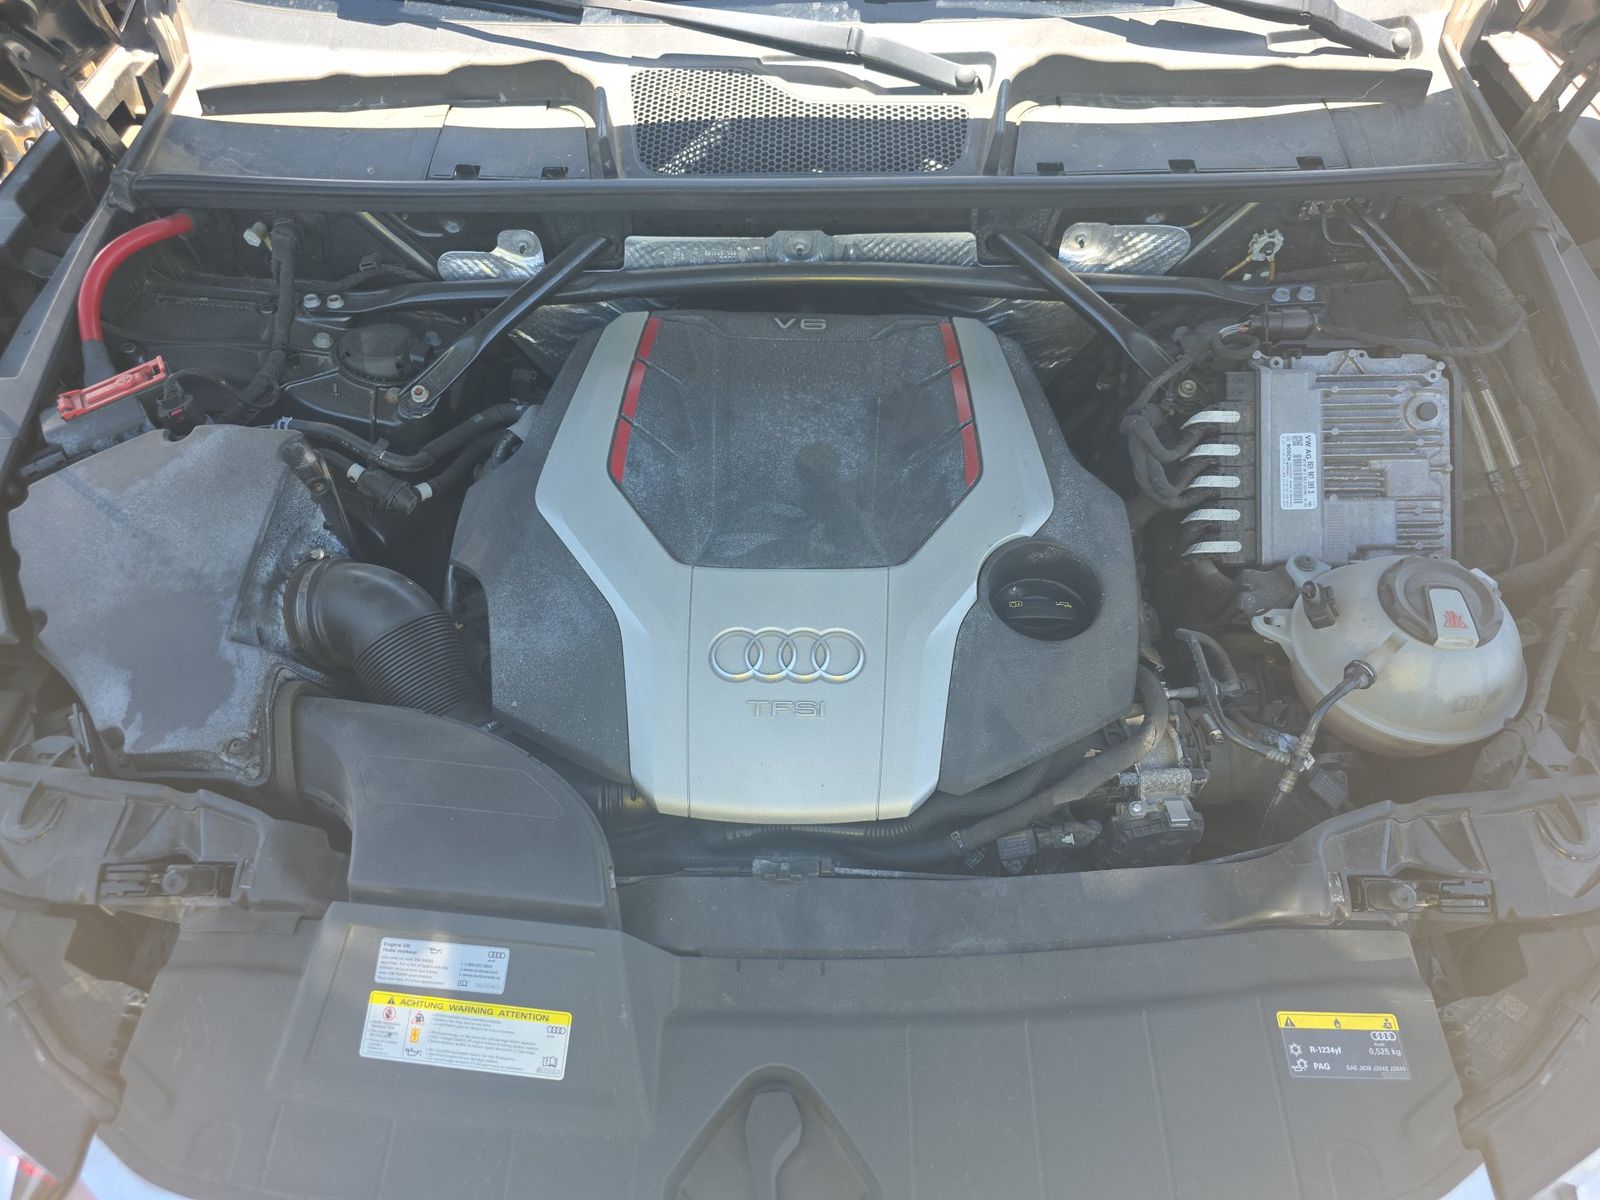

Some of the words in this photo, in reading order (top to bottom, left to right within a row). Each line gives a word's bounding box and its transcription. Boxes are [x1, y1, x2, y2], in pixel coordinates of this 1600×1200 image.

[773, 317, 827, 330] V6
[1304, 435, 1312, 447] VW
[1305, 449, 1312, 460] AG
[746, 699, 825, 718] TFSI
[400, 998, 444, 1010] ACHTUNG
[449, 1004, 493, 1016] WARNING
[498, 1010, 549, 1022] ATTENTION
[1309, 1045, 1342, 1056] R-1234yf
[1368, 1047, 1390, 1056] 0,525
[1391, 1048, 1402, 1057] kg
[1313, 1062, 1331, 1071] PAG
